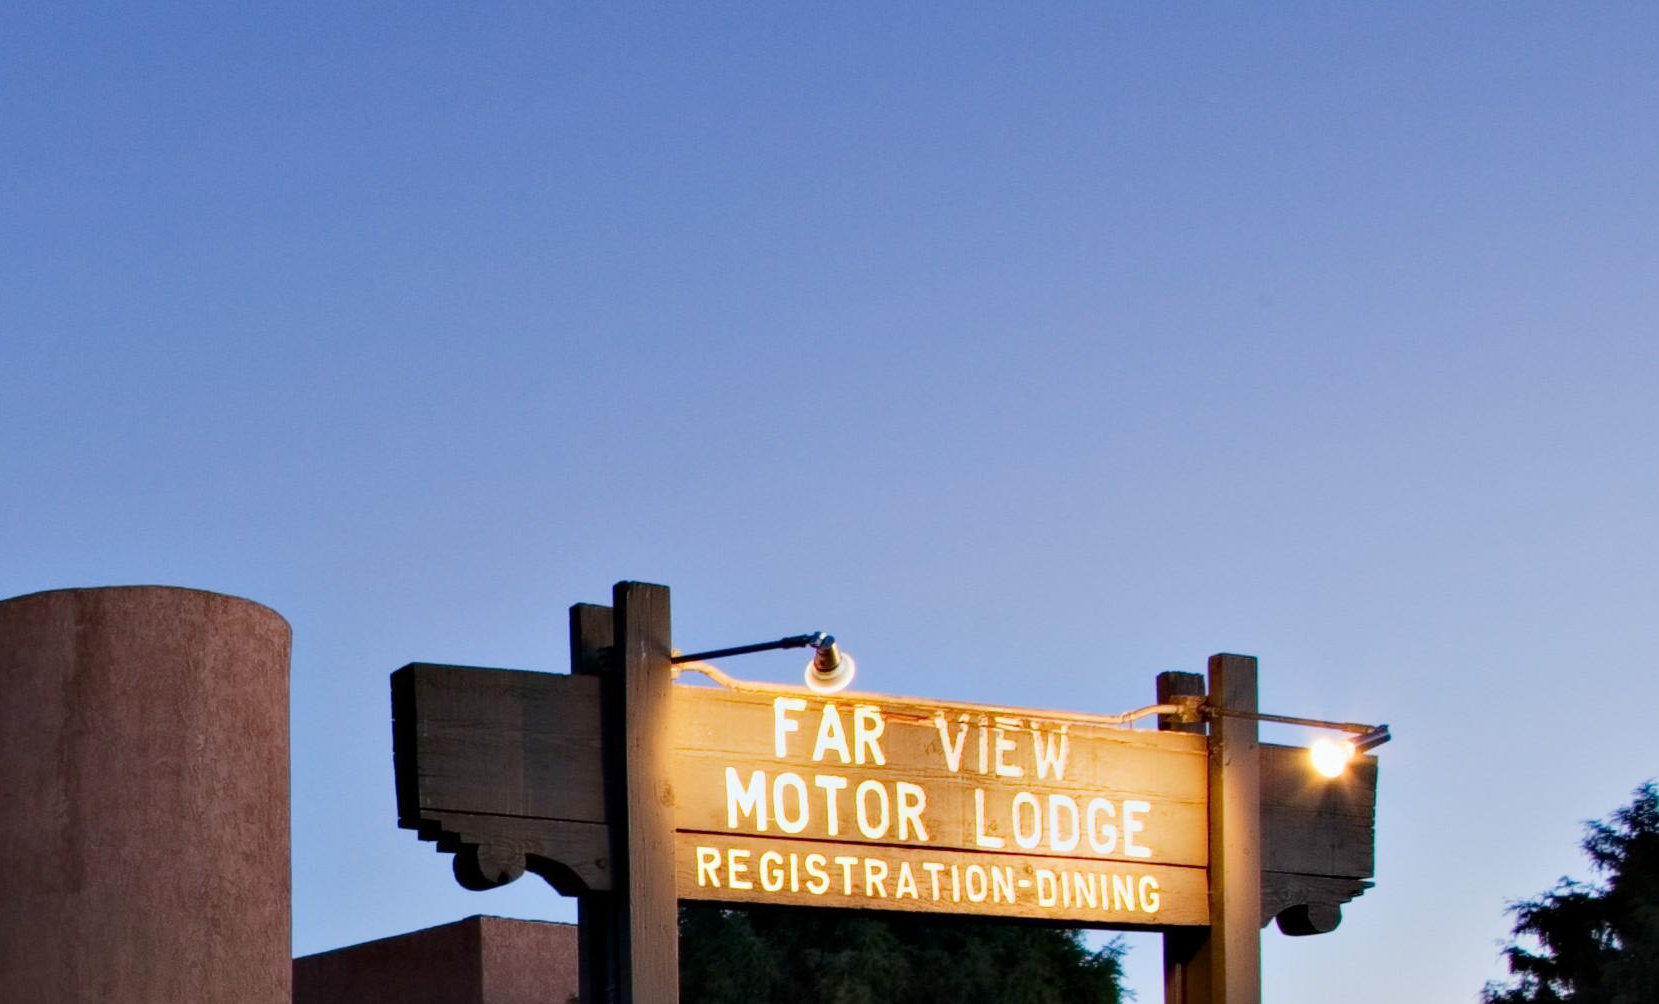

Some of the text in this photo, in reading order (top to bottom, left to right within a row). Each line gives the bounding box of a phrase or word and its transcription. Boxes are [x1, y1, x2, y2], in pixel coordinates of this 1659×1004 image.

[773, 697, 1070, 781] FAR VIEW
[725, 767, 1152, 858] MOTOR LODGE
